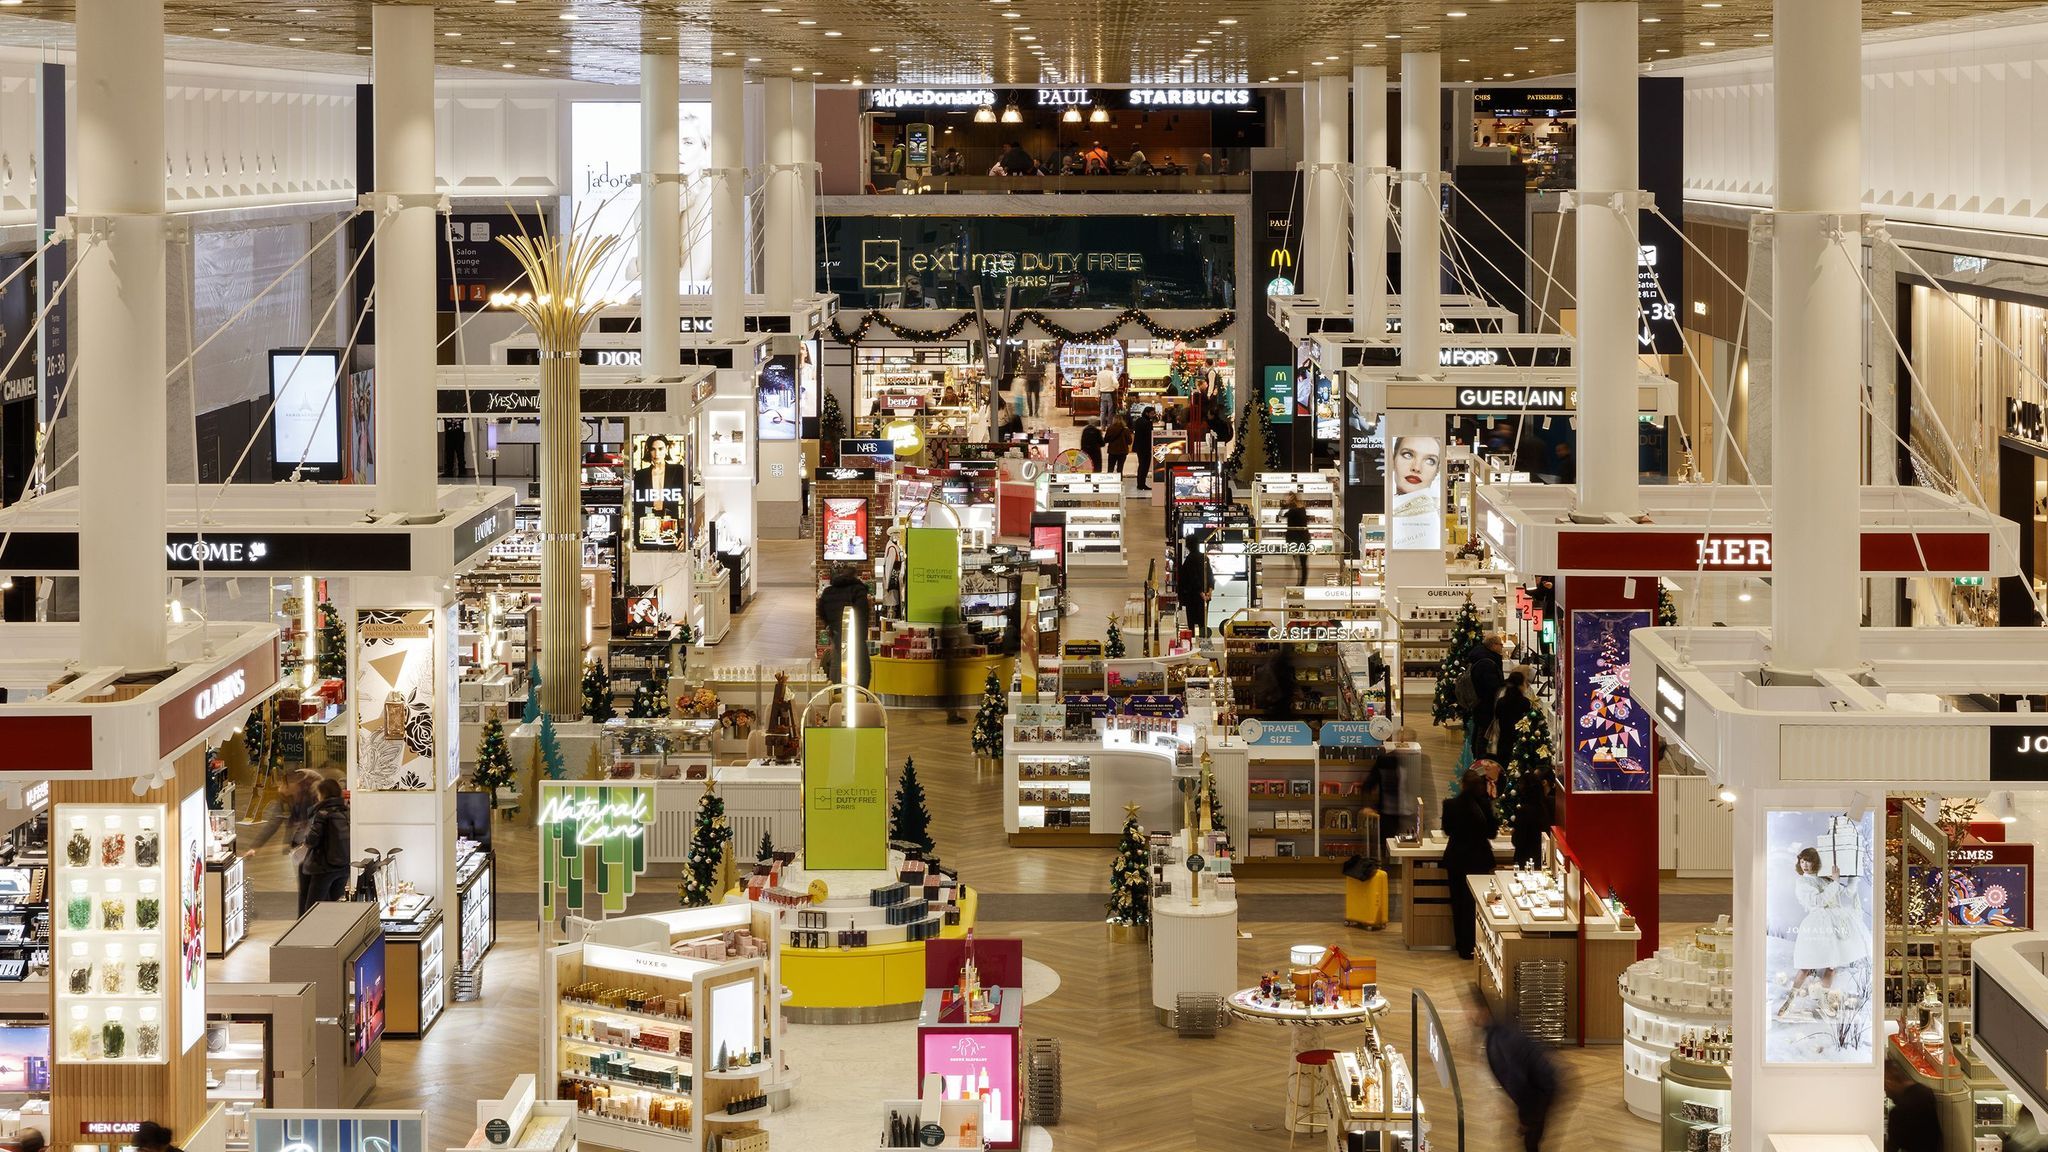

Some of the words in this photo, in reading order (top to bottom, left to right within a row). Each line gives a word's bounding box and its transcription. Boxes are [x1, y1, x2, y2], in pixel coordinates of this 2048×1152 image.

[901, 90, 995, 105] McDonald's
[1038, 90, 1092, 105] PAUL
[1129, 90, 1250, 105] STARBUCKS
[456, 248, 477, 256] Salon
[911, 246, 1017, 272] extime
[1022, 252, 1083, 271] DUTY
[1087, 252, 1143, 271] FREE
[1005, 275, 1047, 286] PARIS
[1638, 303, 1676, 320] -38
[597, 351, 642, 366] DIOR
[1453, 351, 1498, 365] FORD
[47, 353, 65, 377] 26-38
[4, 376, 37, 401] CHANEL
[489, 393, 511, 409] YVES
[887, 396, 918, 407] benefit
[1459, 389, 1563, 406] GUERLAIN
[856, 443, 878, 453] NARS
[833, 468, 858, 480] Kiehl's
[635, 488, 682, 503] LIBRE
[598, 507, 616, 515] DIOR
[1696, 539, 1772, 565] HER
[1325, 590, 1361, 598] GUERLAIN
[1427, 590, 1464, 598] GUERLAIN
[1523, 605, 1529, 614] 2
[1533, 616, 1539, 625] 3
[1267, 627, 1310, 640] CASH
[1315, 627, 1360, 640] DESK
[195, 669, 245, 720] CLARINS
[1263, 724, 1300, 733] TRAVEL
[1332, 724, 1369, 733] TRAVEL
[1270, 735, 1292, 744] SIZE
[1340, 735, 1362, 744] SIZE
[836, 786, 877, 796] extime
[537, 792, 648, 826] Natural
[576, 816, 643, 845] Care
[636, 958, 660, 967] NUXE
[88, 1123, 111, 1133] MEN
[113, 1123, 140, 1133] CARE
